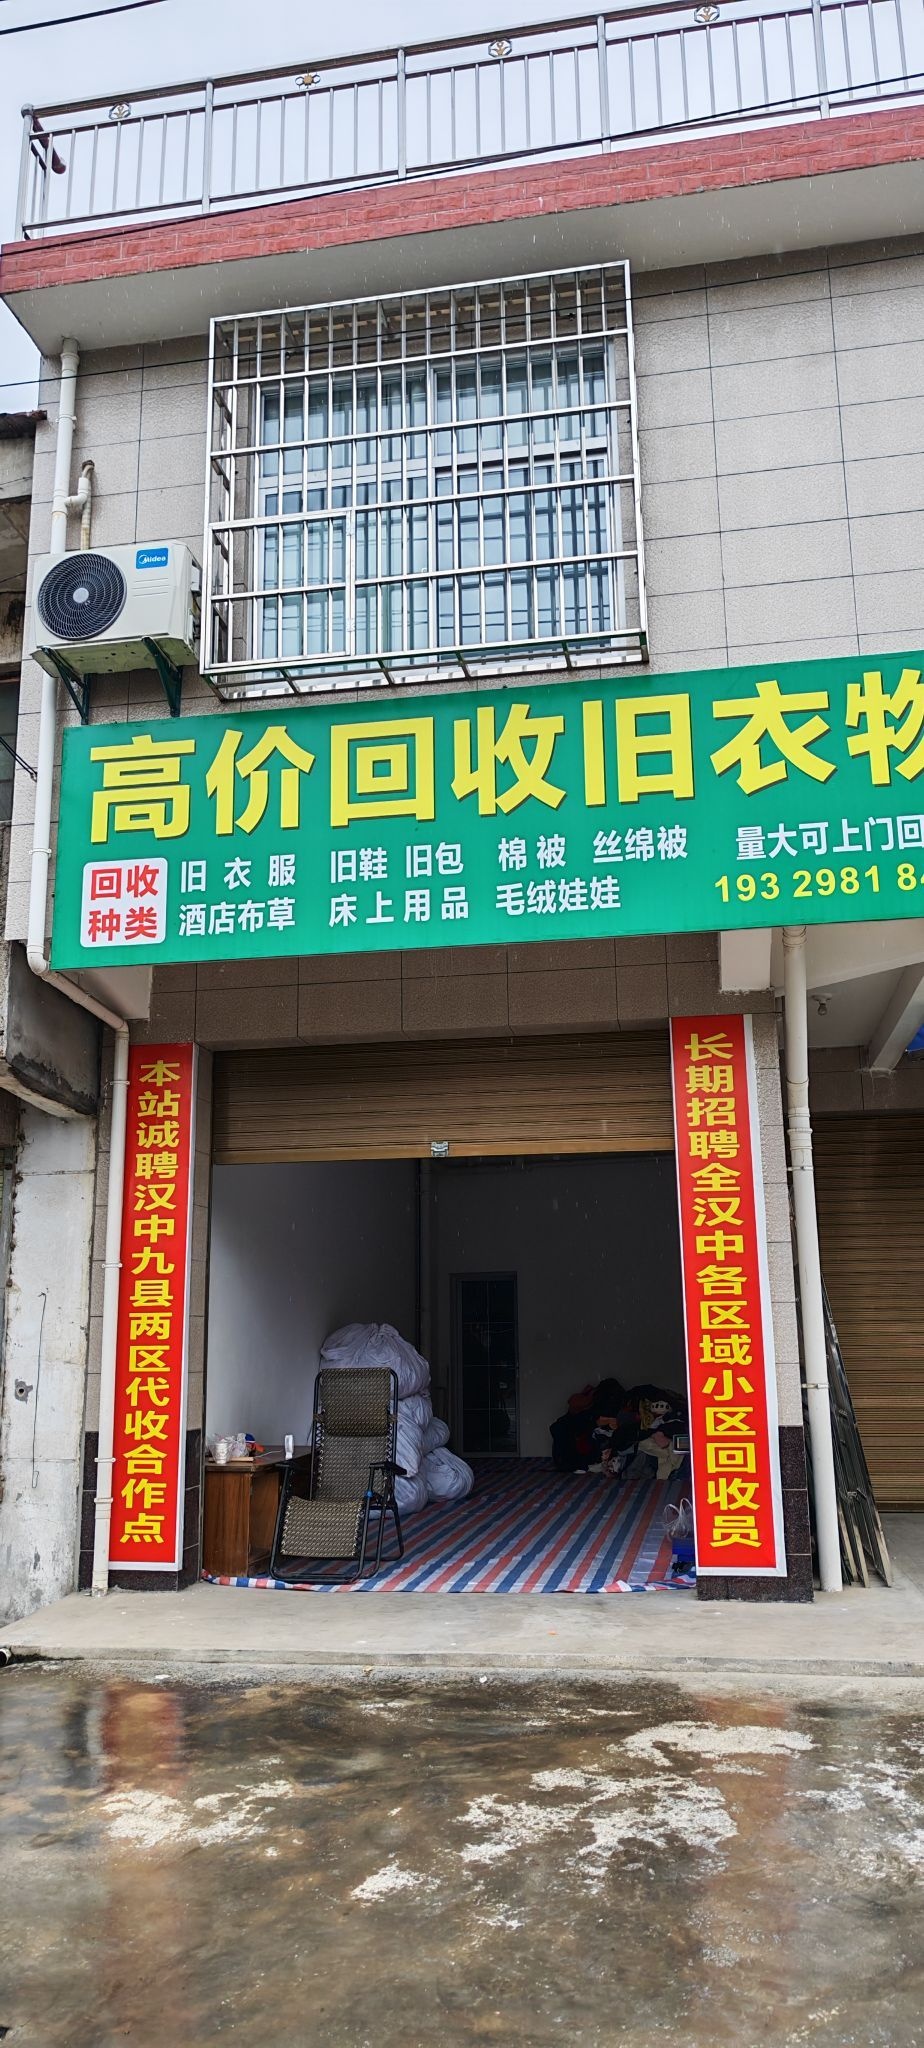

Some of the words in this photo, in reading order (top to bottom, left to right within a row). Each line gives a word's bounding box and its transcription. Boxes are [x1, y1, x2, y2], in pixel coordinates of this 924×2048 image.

[138, 554, 167, 565] Midea
[90, 668, 924, 843] 高价回收旧衣物
[179, 854, 297, 893] 旧衣服
[330, 846, 388, 884] 旧鞋
[405, 842, 465, 879] 旧包
[498, 834, 567, 872] 棉被
[592, 824, 689, 864] 丝绵被
[735, 814, 924, 861] 量大可上门回
[90, 864, 160, 901] 回收
[178, 897, 296, 937] 酒店布草
[329, 886, 470, 928] 床上用品
[495, 874, 622, 917] 毛绒娃娃
[714, 871, 781, 902] 193
[792, 864, 880, 898] 2981
[896, 863, 924, 892] 8
[87, 906, 158, 943] 种类
[119, 1059, 181, 1545] 本站诚聘汉中九县两区代收合作点
[684, 1032, 762, 1549] 长期招聘全汉中各区域小区回收员
